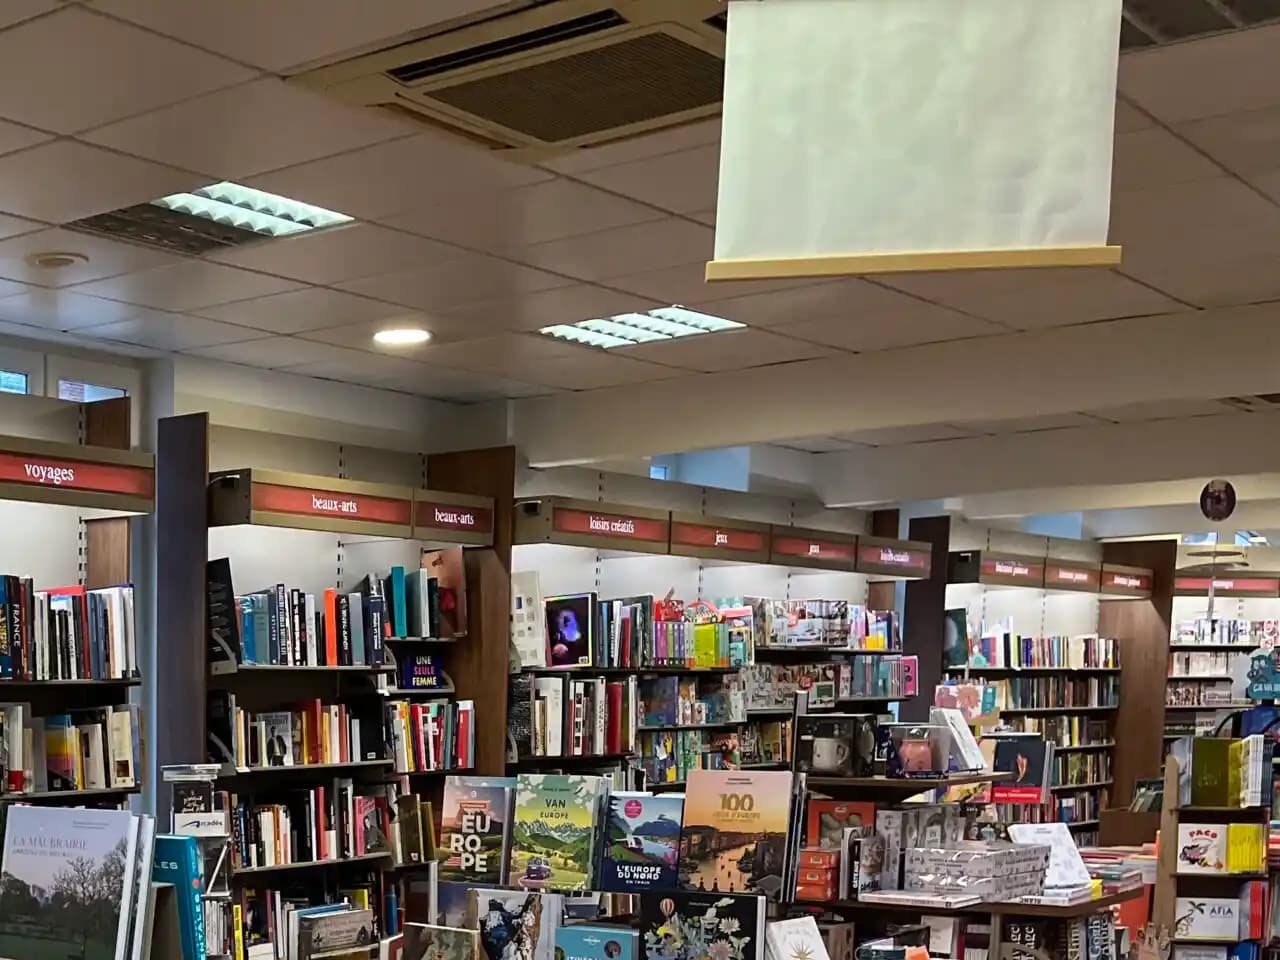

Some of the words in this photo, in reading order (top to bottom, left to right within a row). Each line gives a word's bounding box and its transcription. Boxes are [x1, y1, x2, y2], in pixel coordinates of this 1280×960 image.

[23, 461, 75, 485] voyages
[311, 494, 358, 515] beaux-arts
[434, 508, 475, 526] beaux-arts
[589, 515, 610, 531] loisirs
[610, 518, 634, 534] créatifs
[13, 603, 21, 647] FRANCE
[416, 655, 432, 665] UNE
[413, 666, 435, 675] SEULE
[412, 676, 437, 686] FEMME
[545, 798, 566, 809] VAN
[719, 793, 756, 811] 100
[540, 811, 569, 819] EUROPE
[461, 815, 491, 835] EU
[450, 834, 482, 853] RO
[1188, 831, 1218, 840] PACO
[460, 854, 488, 873] PE
[616, 864, 662, 874] L'EUROPE
[617, 871, 631, 880] DU
[1089, 918, 1101, 957] Gogh
